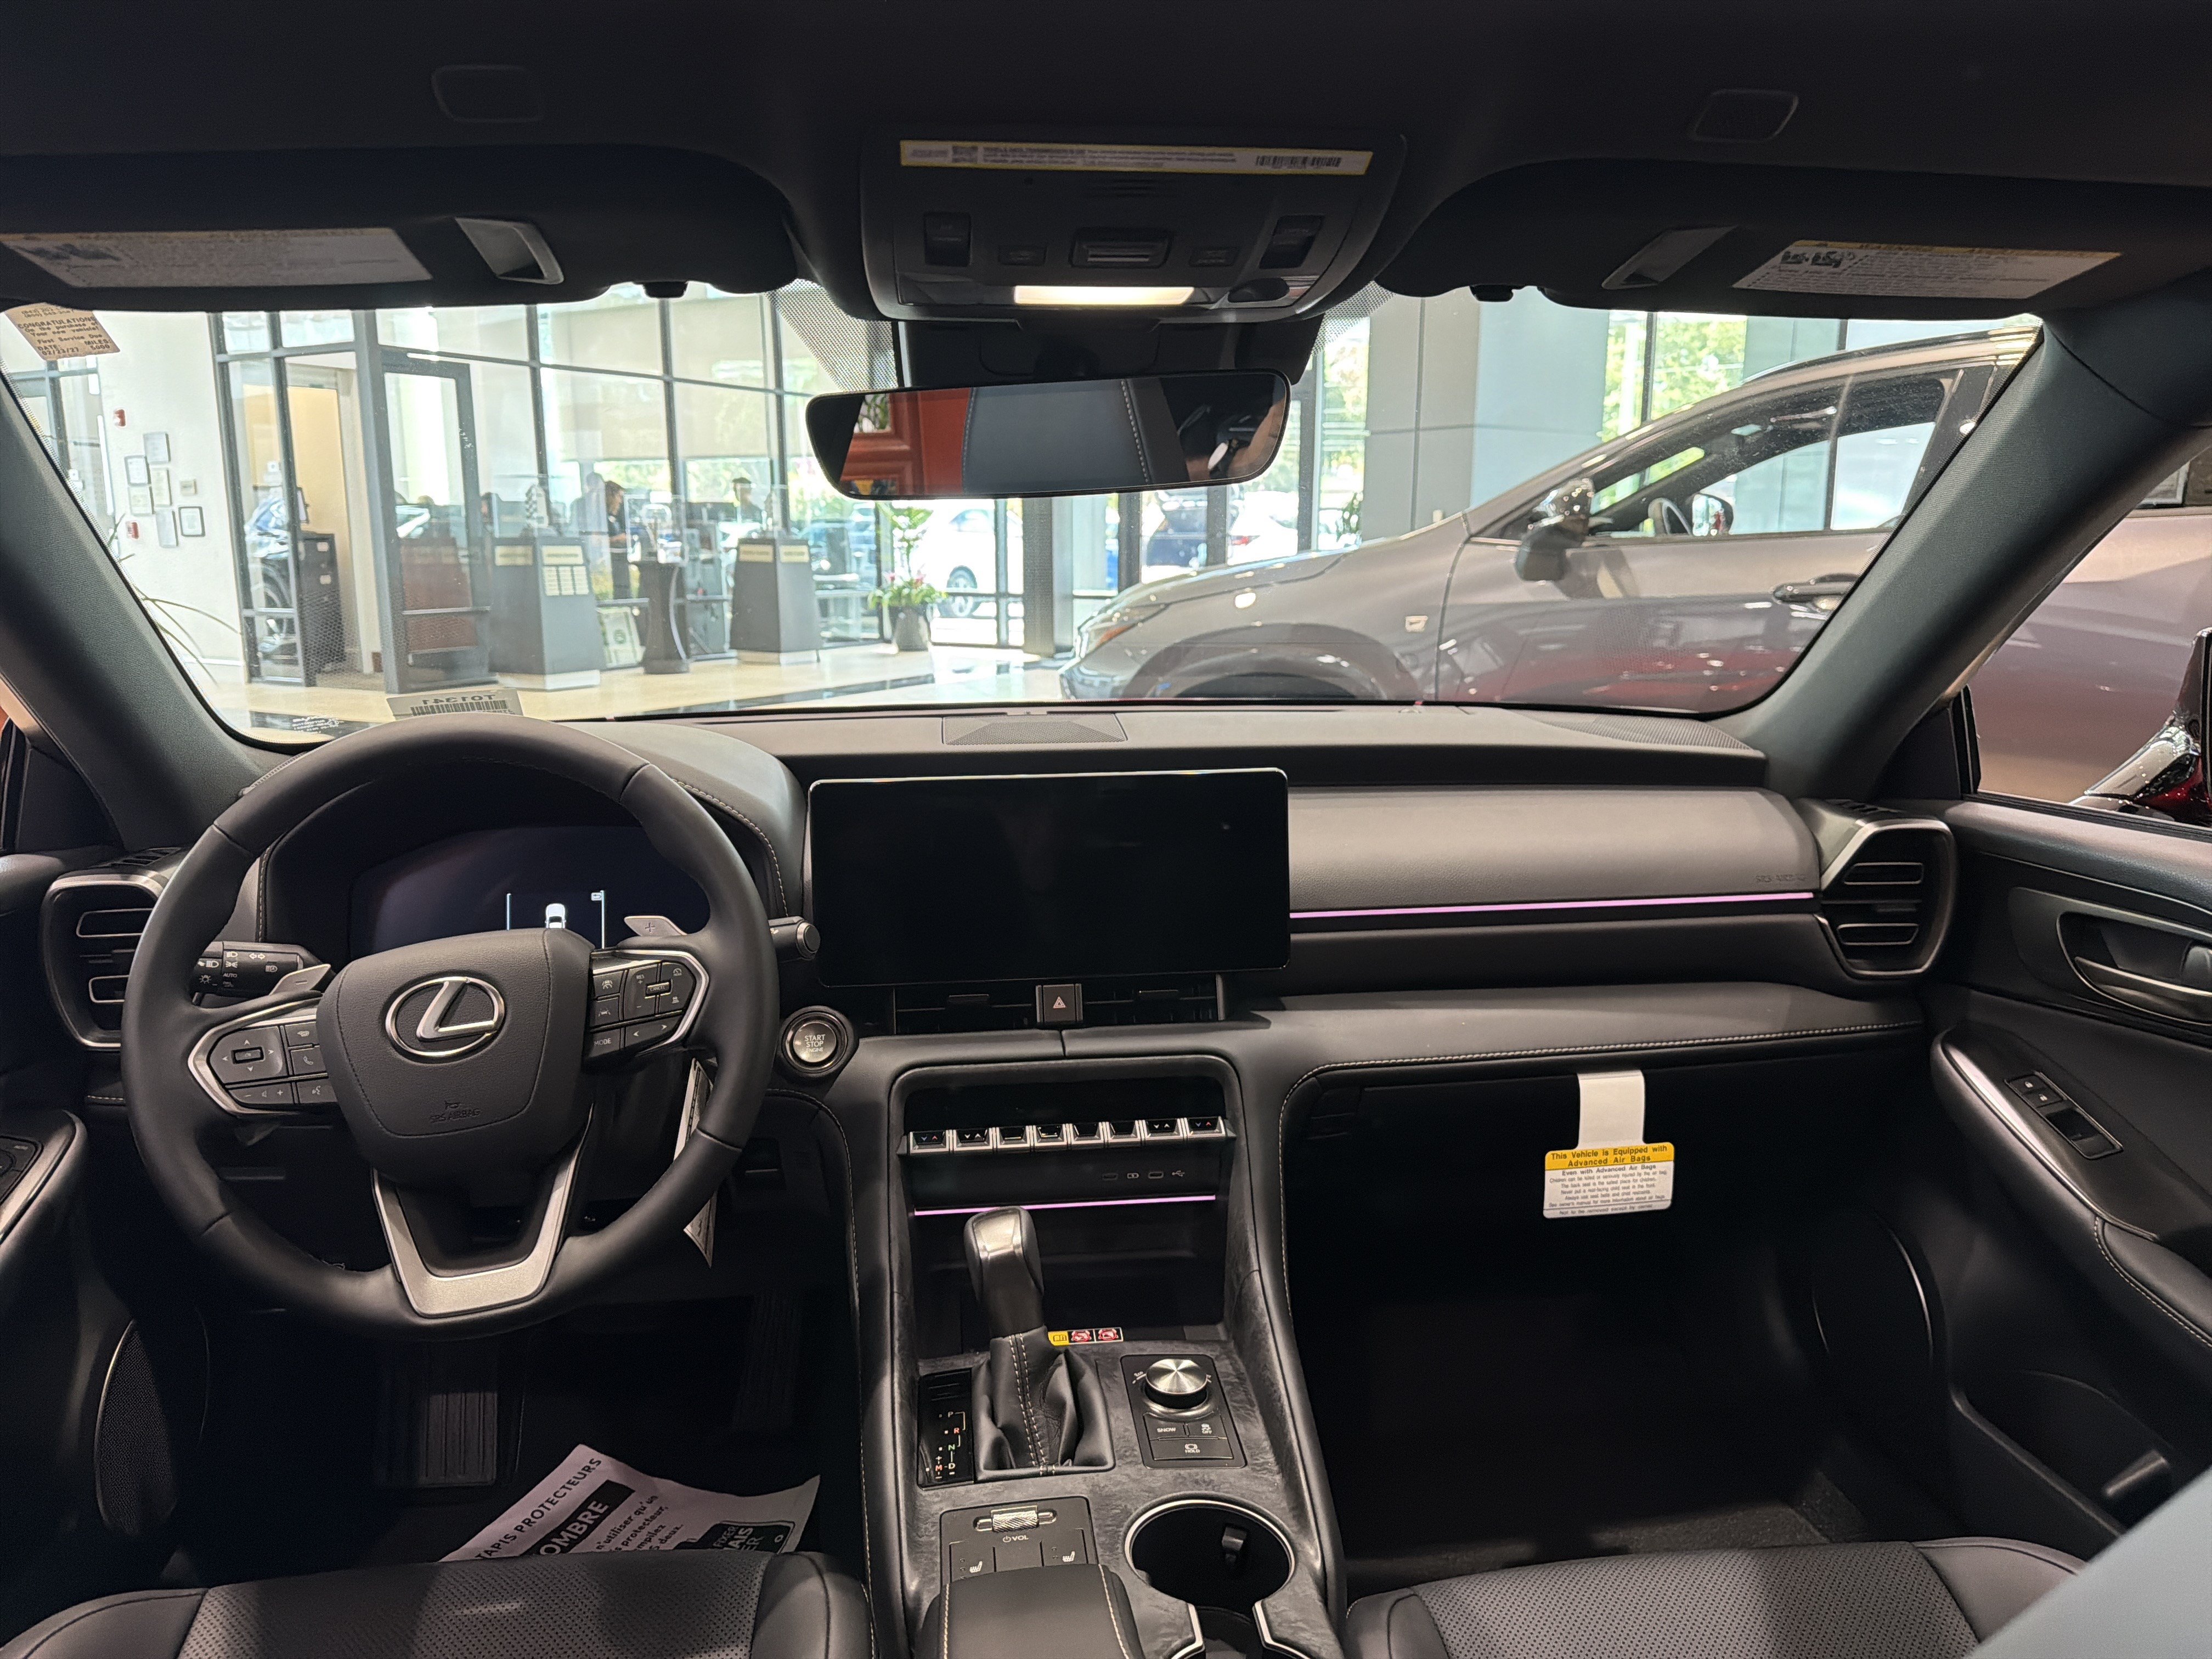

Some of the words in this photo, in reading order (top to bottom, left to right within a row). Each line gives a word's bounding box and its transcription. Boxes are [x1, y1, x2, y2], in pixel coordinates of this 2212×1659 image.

[18, 316, 96, 329] CONGRATULATIONS
[1571, 1150, 1599, 1158] Vehicle
[1613, 1147, 1648, 1156] Equipped
[1568, 1158, 1608, 1167] Advanced
[475, 1533, 517, 1559] TAPIS
[514, 1458, 602, 1533] PROTECTEURS
[634, 1525, 667, 1551] mpilez
[723, 1527, 753, 1550] AIS
